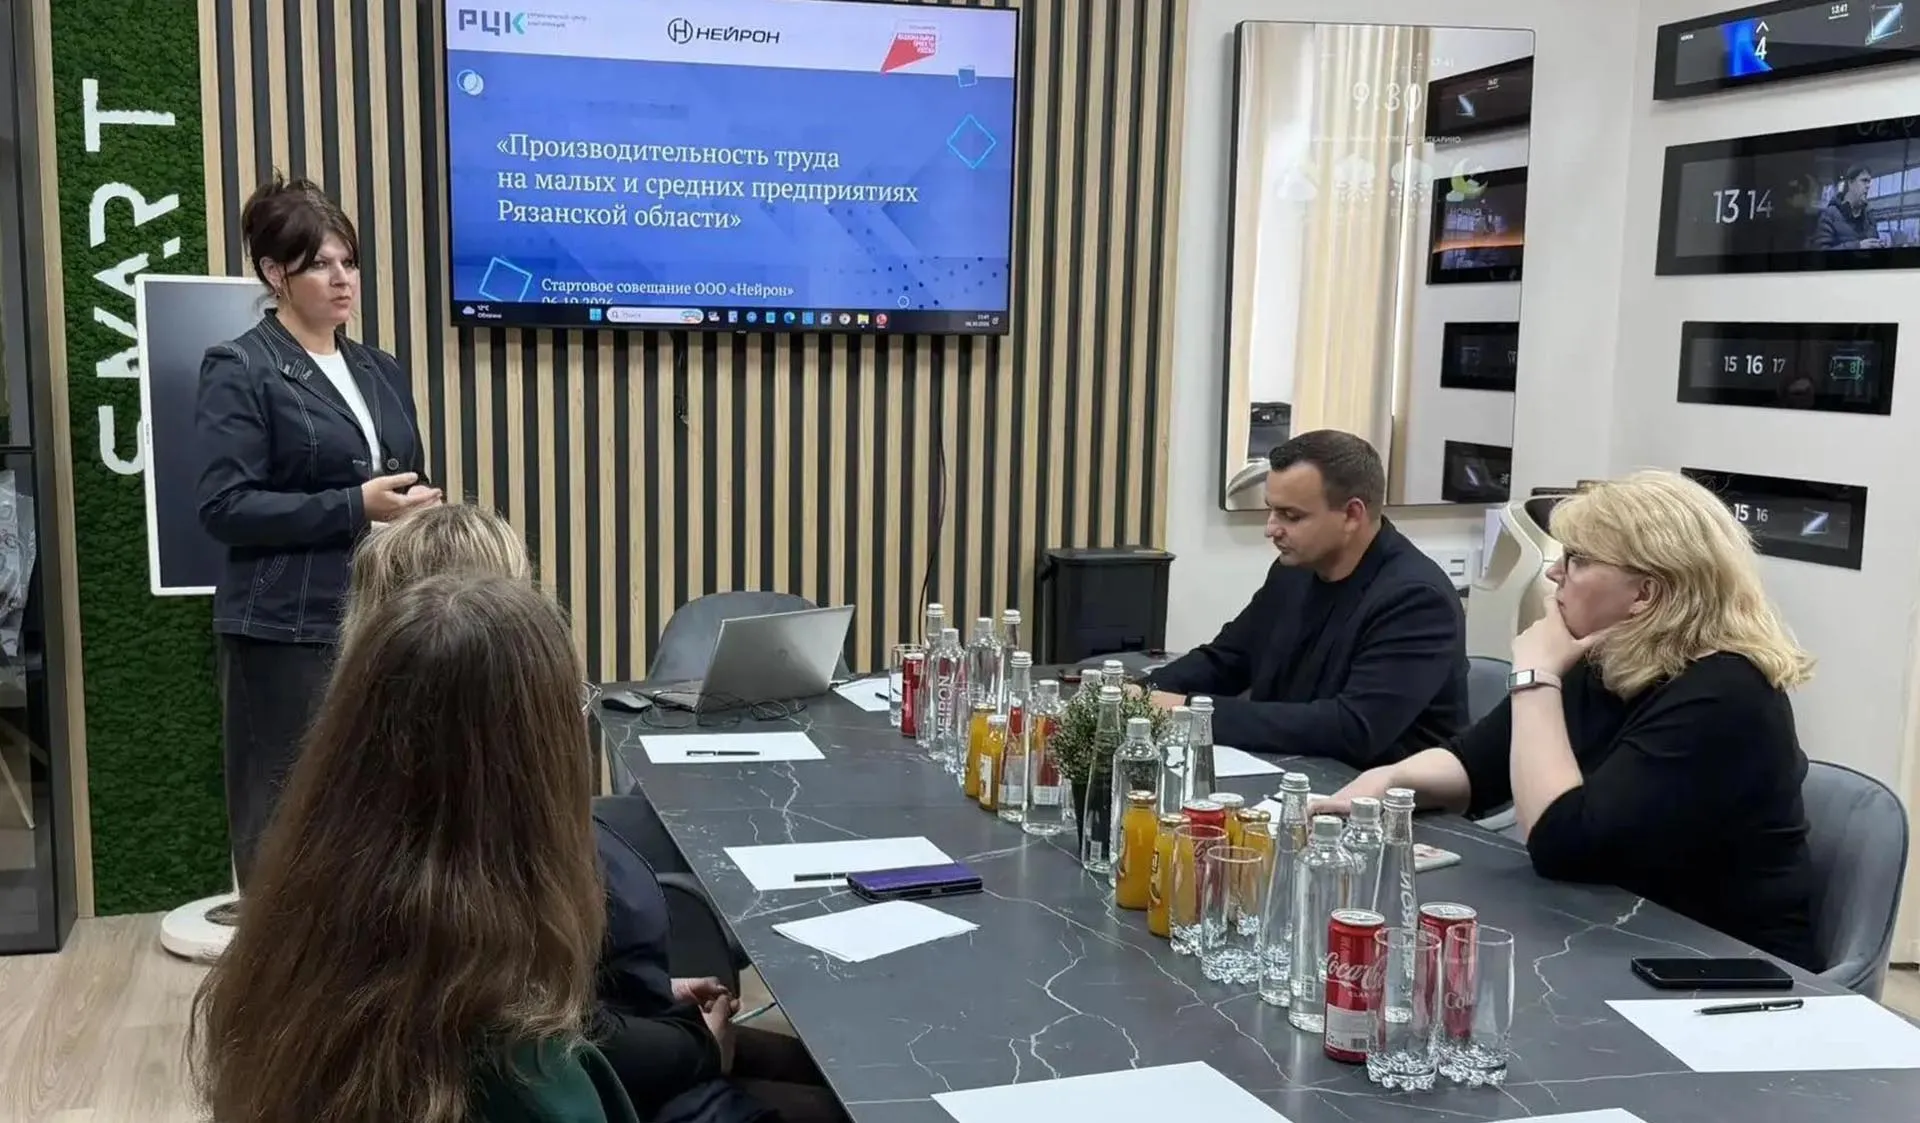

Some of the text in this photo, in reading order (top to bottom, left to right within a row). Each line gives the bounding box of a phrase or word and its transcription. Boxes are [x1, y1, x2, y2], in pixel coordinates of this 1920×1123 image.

[459, 9, 525, 36] РЦК
[696, 27, 780, 43] НЕЙРОН
[1754, 36, 1767, 60] 4
[496, 133, 840, 172] «Производительность труда
[498, 171, 918, 205] на малых и средних предприятиях
[498, 199, 742, 228] Рязанской области»
[1713, 188, 1773, 224] 13 14
[541, 278, 794, 298] Стартовое совещание ООО «Нейрон»
[1724, 355, 1787, 375] 15 16 17
[1734, 503, 1769, 522] 15 16
